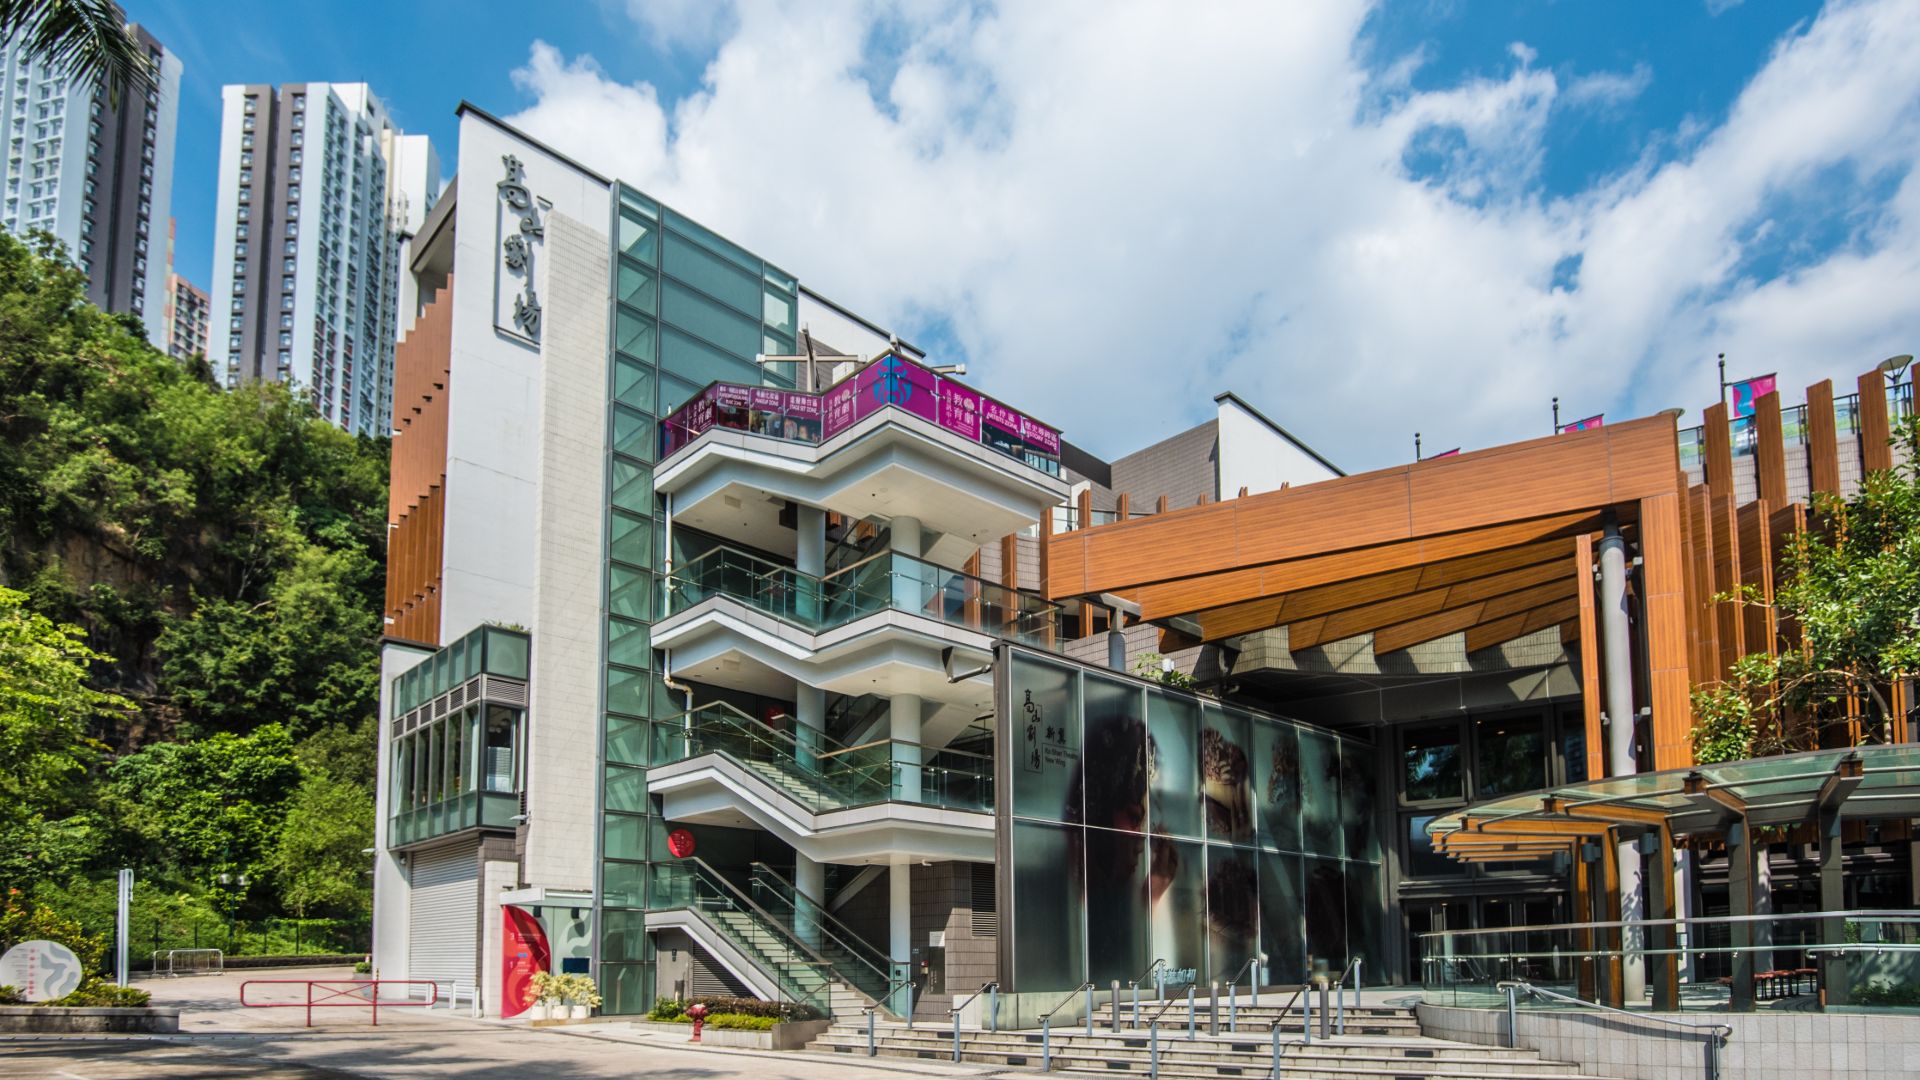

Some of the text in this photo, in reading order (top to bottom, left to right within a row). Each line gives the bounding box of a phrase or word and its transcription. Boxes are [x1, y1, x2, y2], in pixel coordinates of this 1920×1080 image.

[806, 405, 817, 413] ZONE
[953, 392, 963, 421] 教育
[1004, 419, 1018, 431] ZONE
[1051, 748, 1063, 757] Shan
[1045, 756, 1066, 768] New Wing
